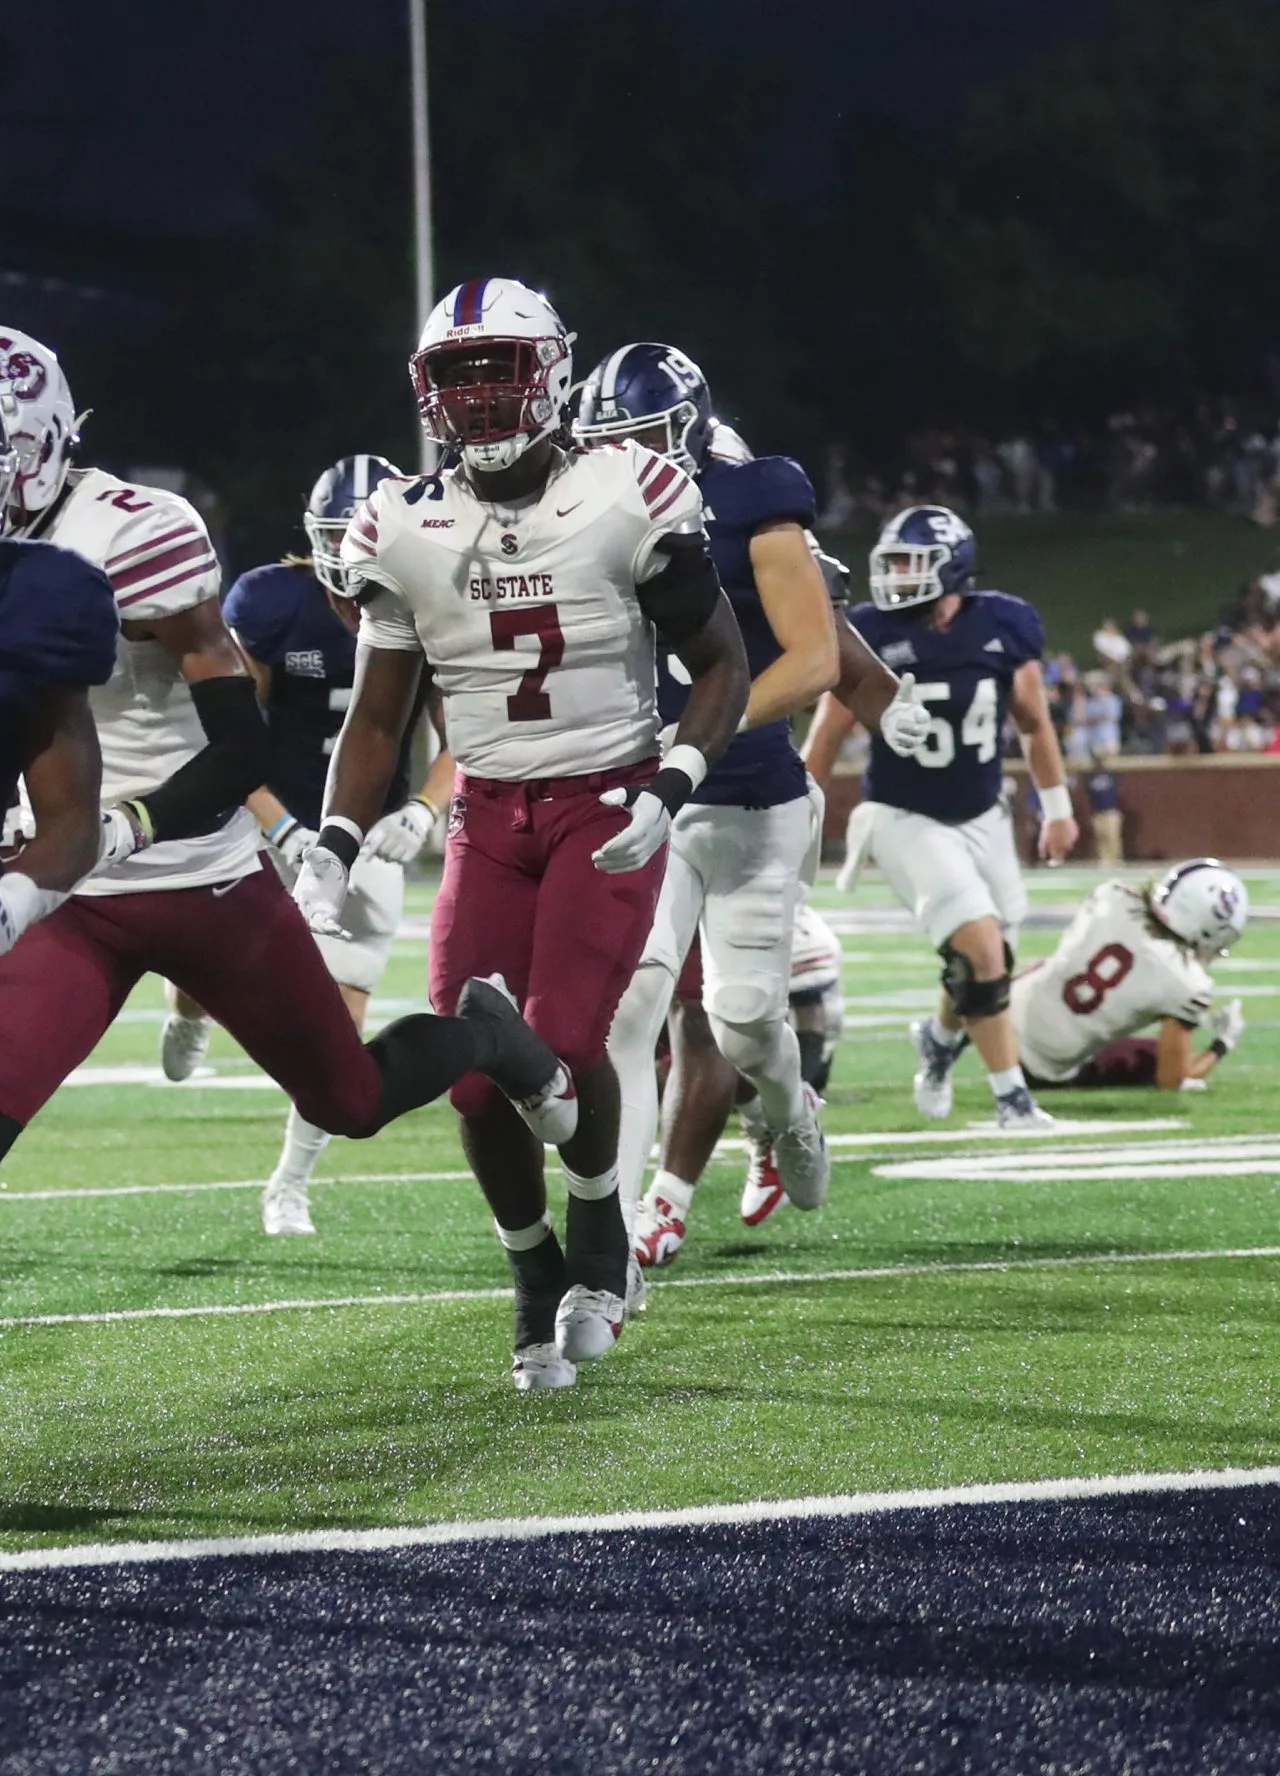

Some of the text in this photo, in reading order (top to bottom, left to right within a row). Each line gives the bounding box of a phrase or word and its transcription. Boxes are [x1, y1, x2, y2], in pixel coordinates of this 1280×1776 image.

[447, 325, 484, 337] Riddll
[420, 518, 455, 529] MEAC
[470, 574, 553, 600] SC STATE
[489, 603, 565, 722] 7
[912, 677, 997, 769] 54
[1062, 943, 1134, 1015] 8
